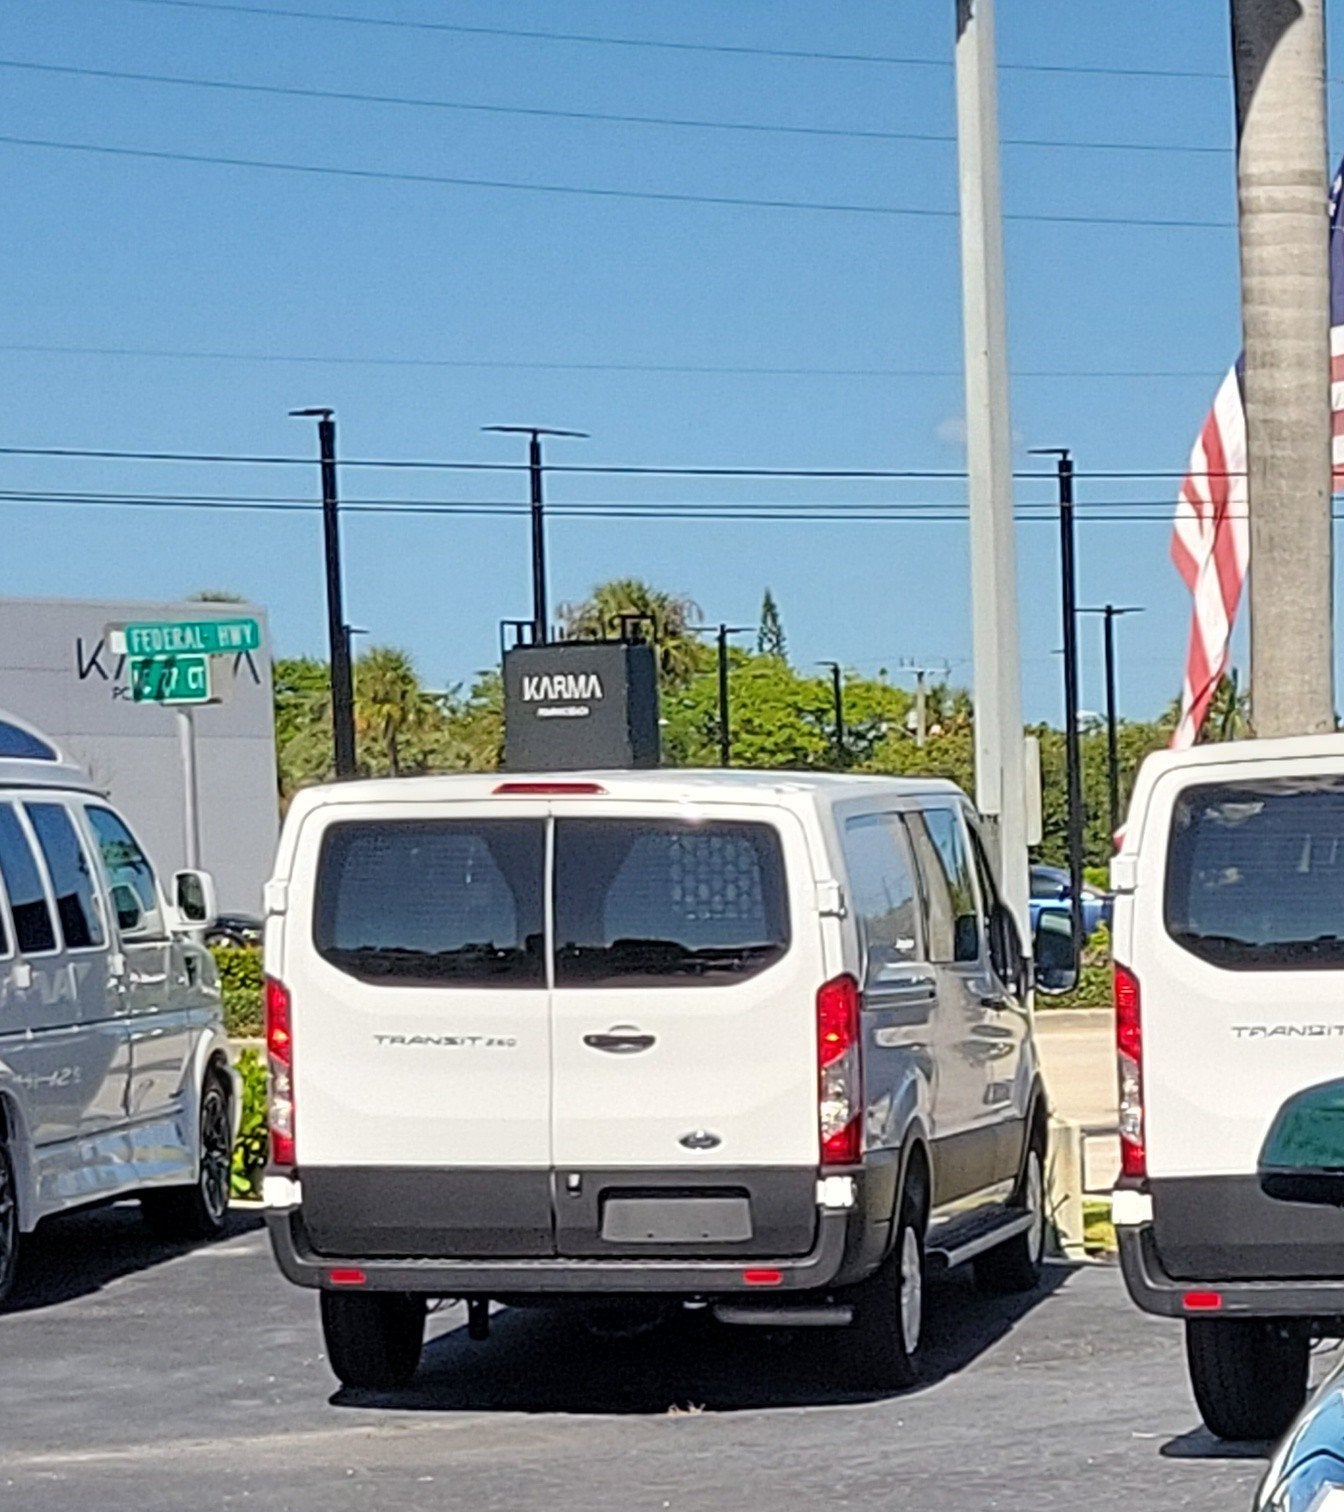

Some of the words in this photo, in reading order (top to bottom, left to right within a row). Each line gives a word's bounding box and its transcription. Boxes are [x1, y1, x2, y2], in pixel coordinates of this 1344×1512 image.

[131, 625, 205, 653] FEDERAL
[217, 623, 253, 647] HWY
[522, 674, 603, 701] KARMA
[373, 1034, 483, 1046] TRANSIT
